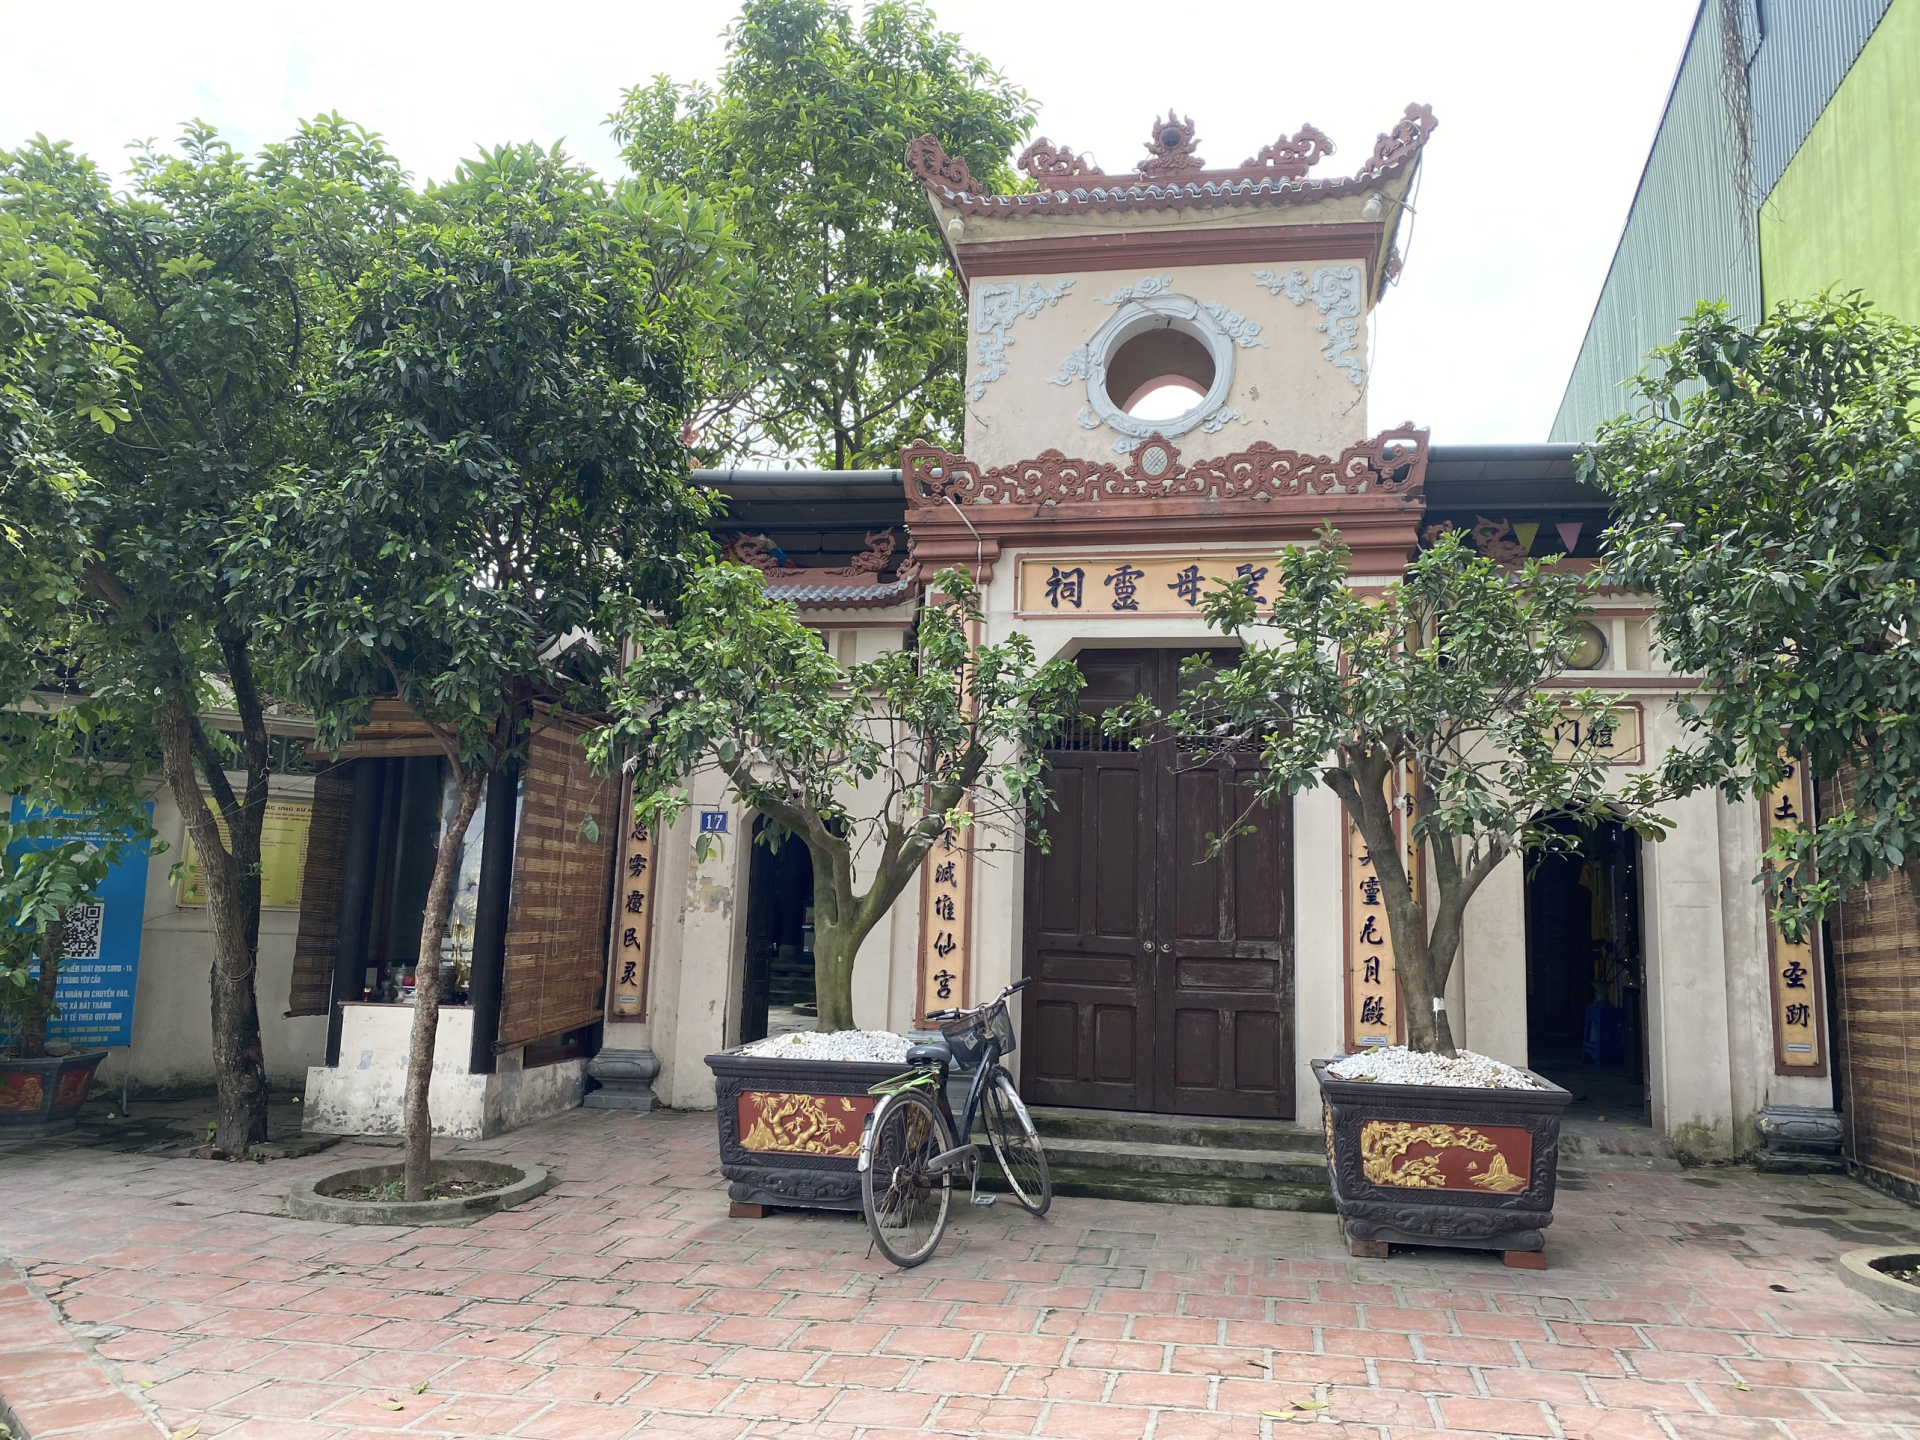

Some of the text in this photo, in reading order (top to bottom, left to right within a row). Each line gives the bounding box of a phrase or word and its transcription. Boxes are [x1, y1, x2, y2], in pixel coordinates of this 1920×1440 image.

[706, 814, 723, 830] 17
[107, 964, 122, 973] COVID
[78, 1013, 94, 1021] THEO
[94, 1012, 106, 1021] QUY
